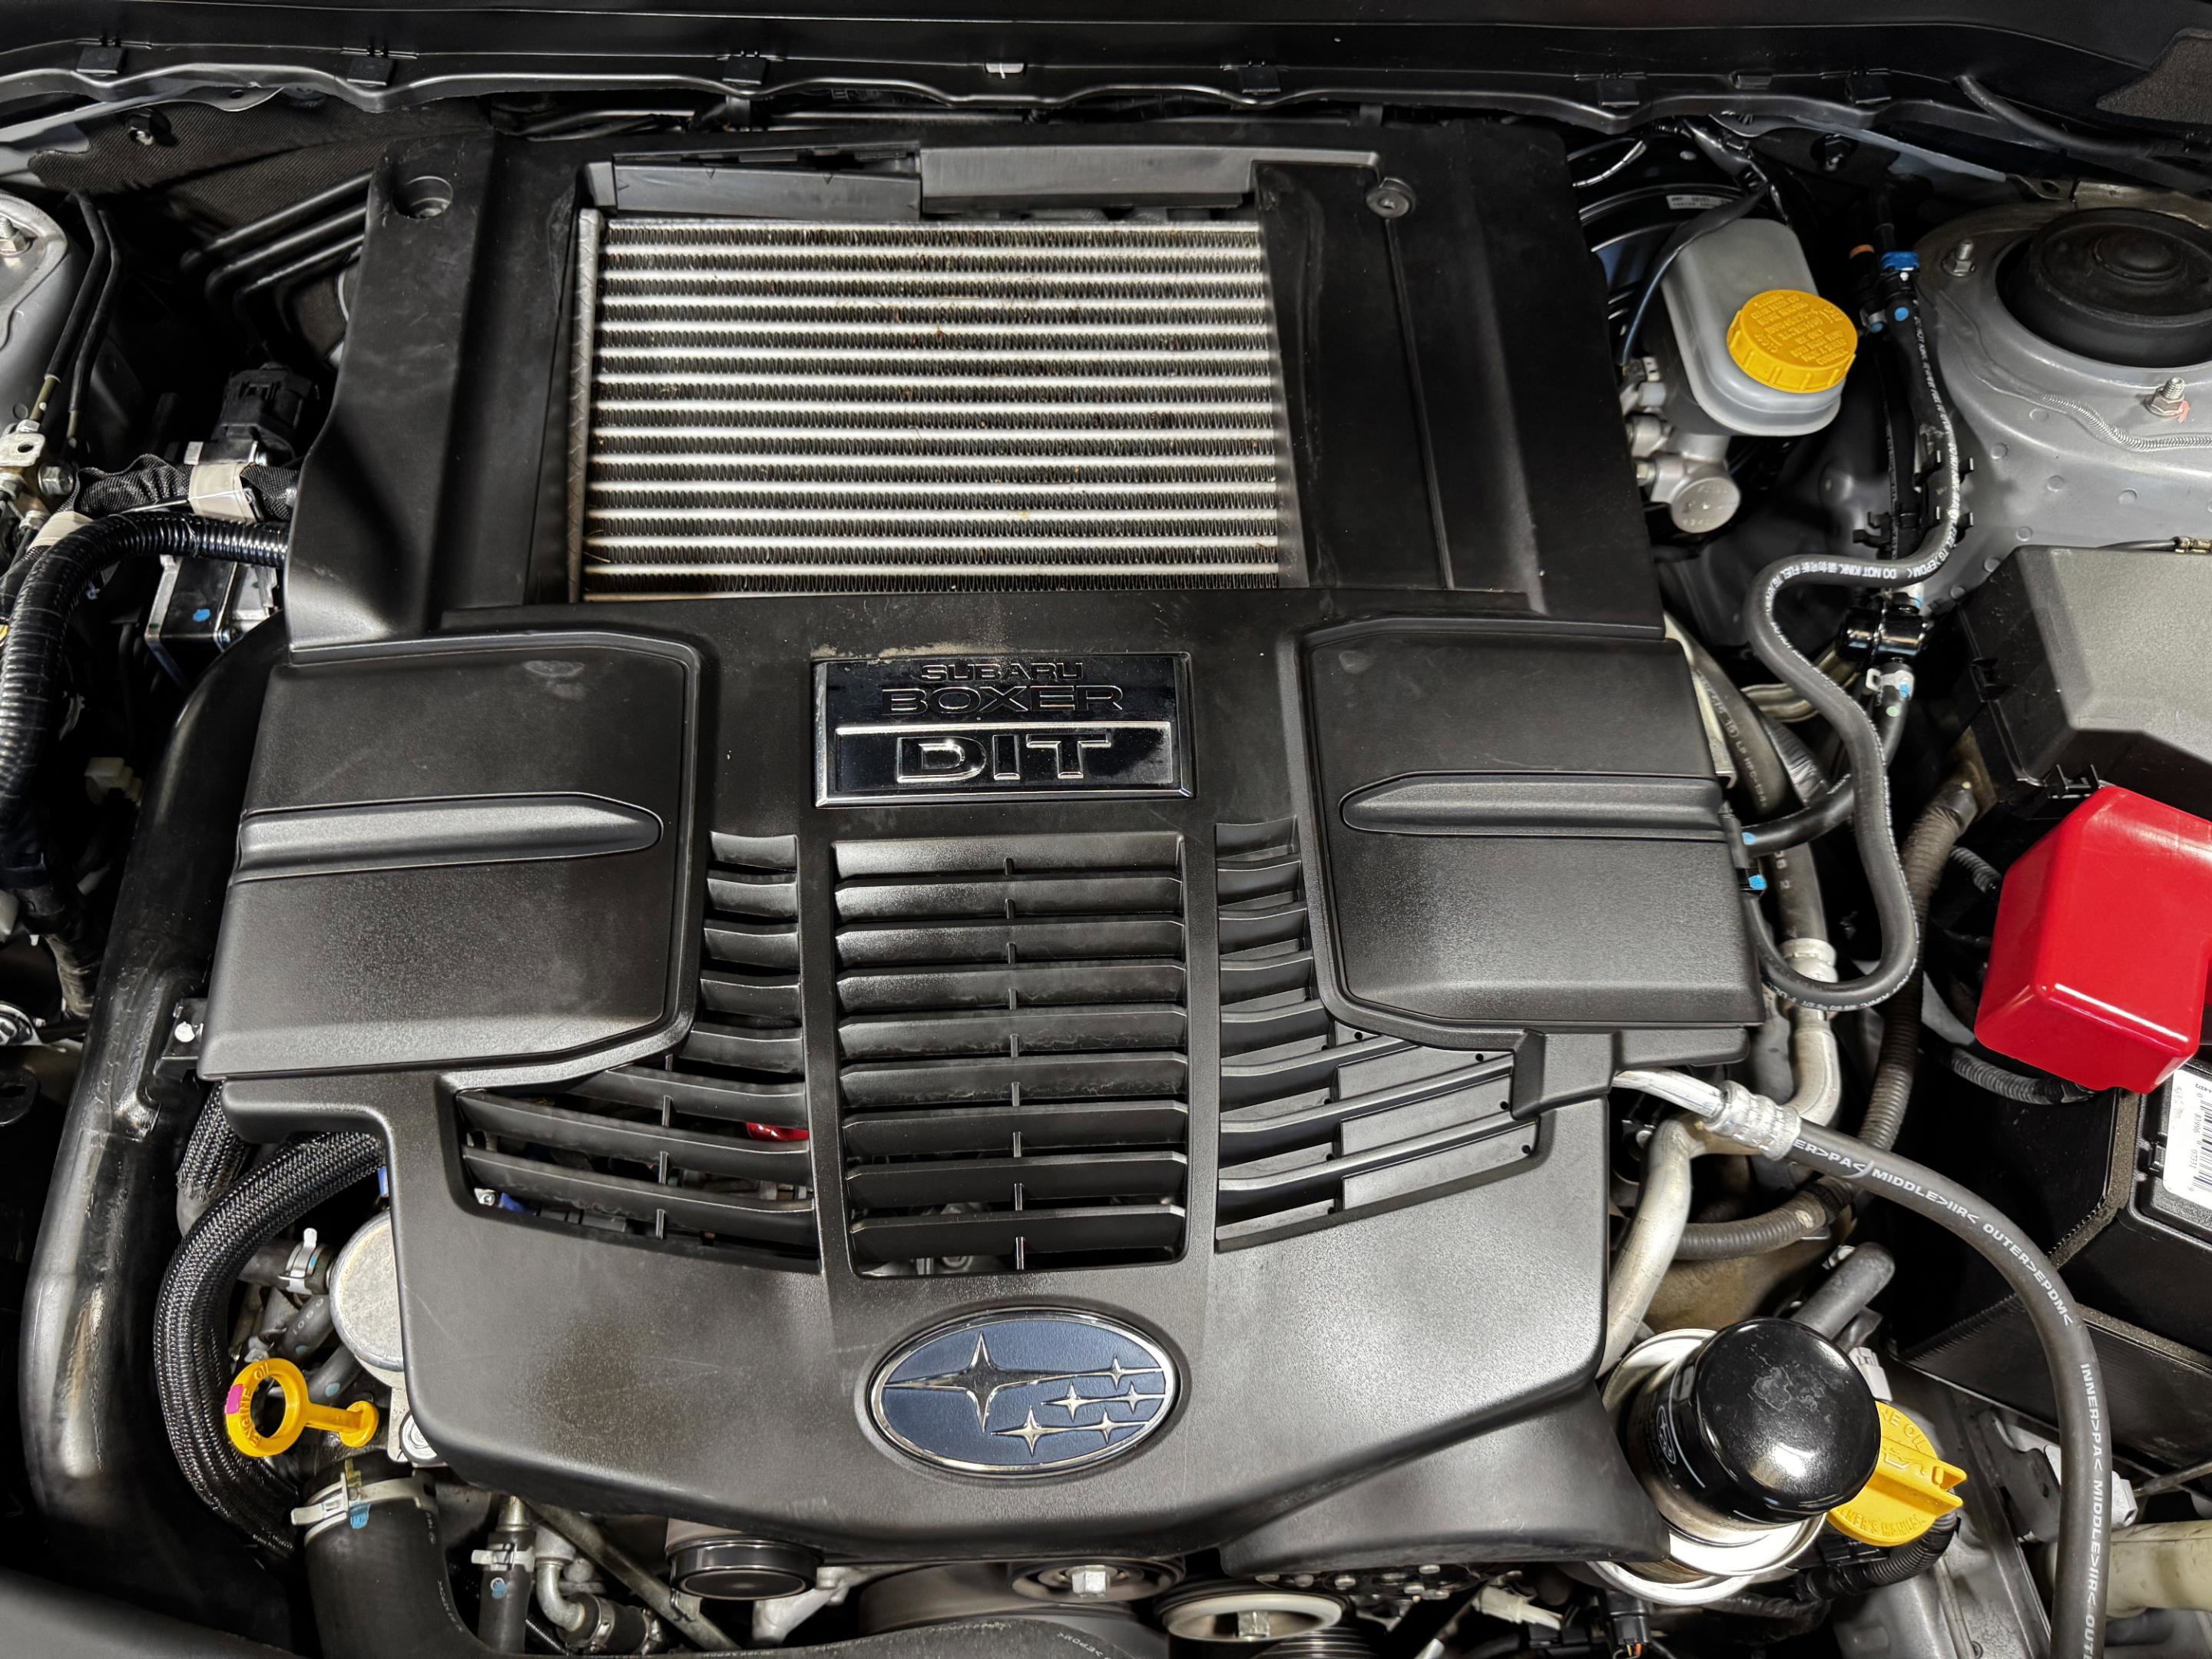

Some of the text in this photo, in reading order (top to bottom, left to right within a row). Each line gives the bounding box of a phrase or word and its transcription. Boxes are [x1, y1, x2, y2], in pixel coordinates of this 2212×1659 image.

[1863, 566, 1882, 578] NOT
[1883, 568, 1897, 579] DO
[921, 662, 1084, 682] SUBARU
[881, 685, 1124, 715] BOXER
[896, 733, 1113, 783] DIT
[1793, 1138, 1866, 1174] ER>PA<
[1982, 1223, 2074, 1327] OUTER>EPDM<
[238, 1361, 270, 1448] ENGINE OIL
[2080, 1363, 2103, 1472] INNER>PA<
[1902, 1425, 1926, 1450] OIL
